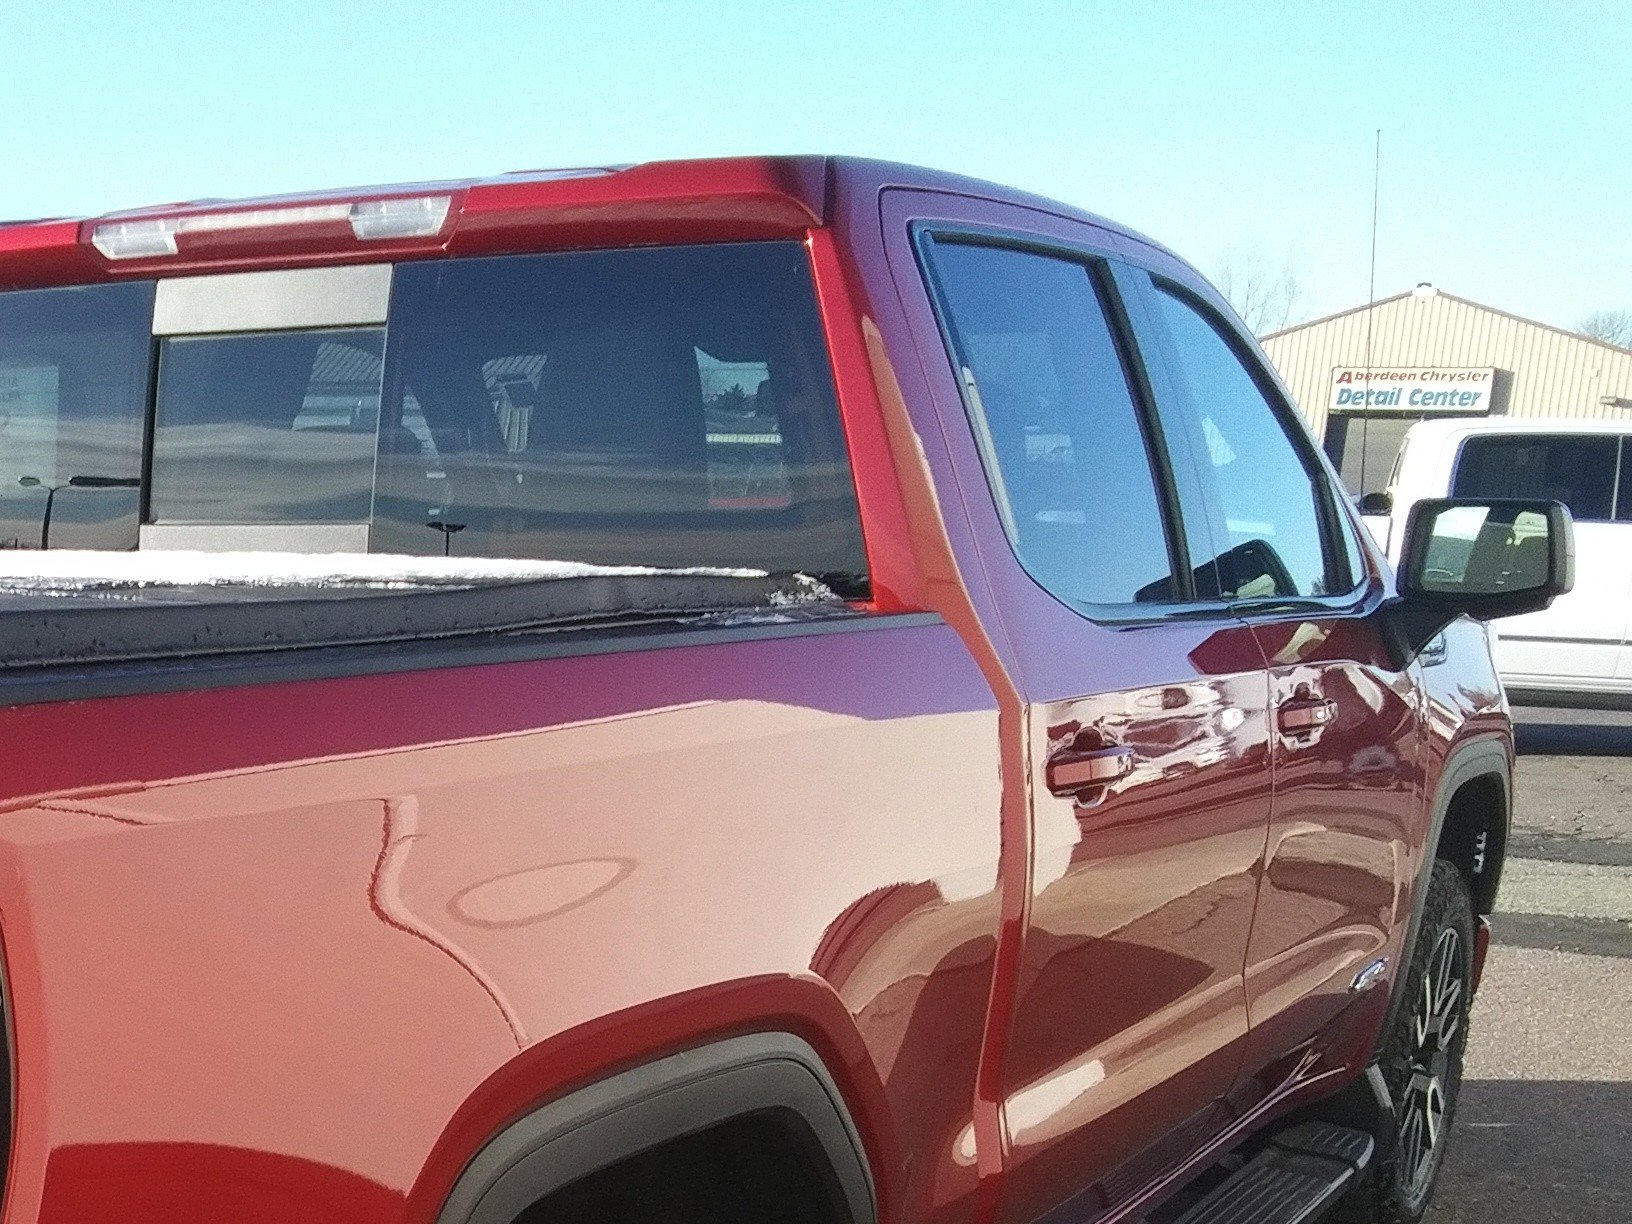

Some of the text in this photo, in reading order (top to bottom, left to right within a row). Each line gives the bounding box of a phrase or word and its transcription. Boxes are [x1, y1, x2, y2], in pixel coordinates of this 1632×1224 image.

[1335, 371, 1490, 384] Aberdeen Chrysler
[1336, 387, 1482, 407] Detail Center
